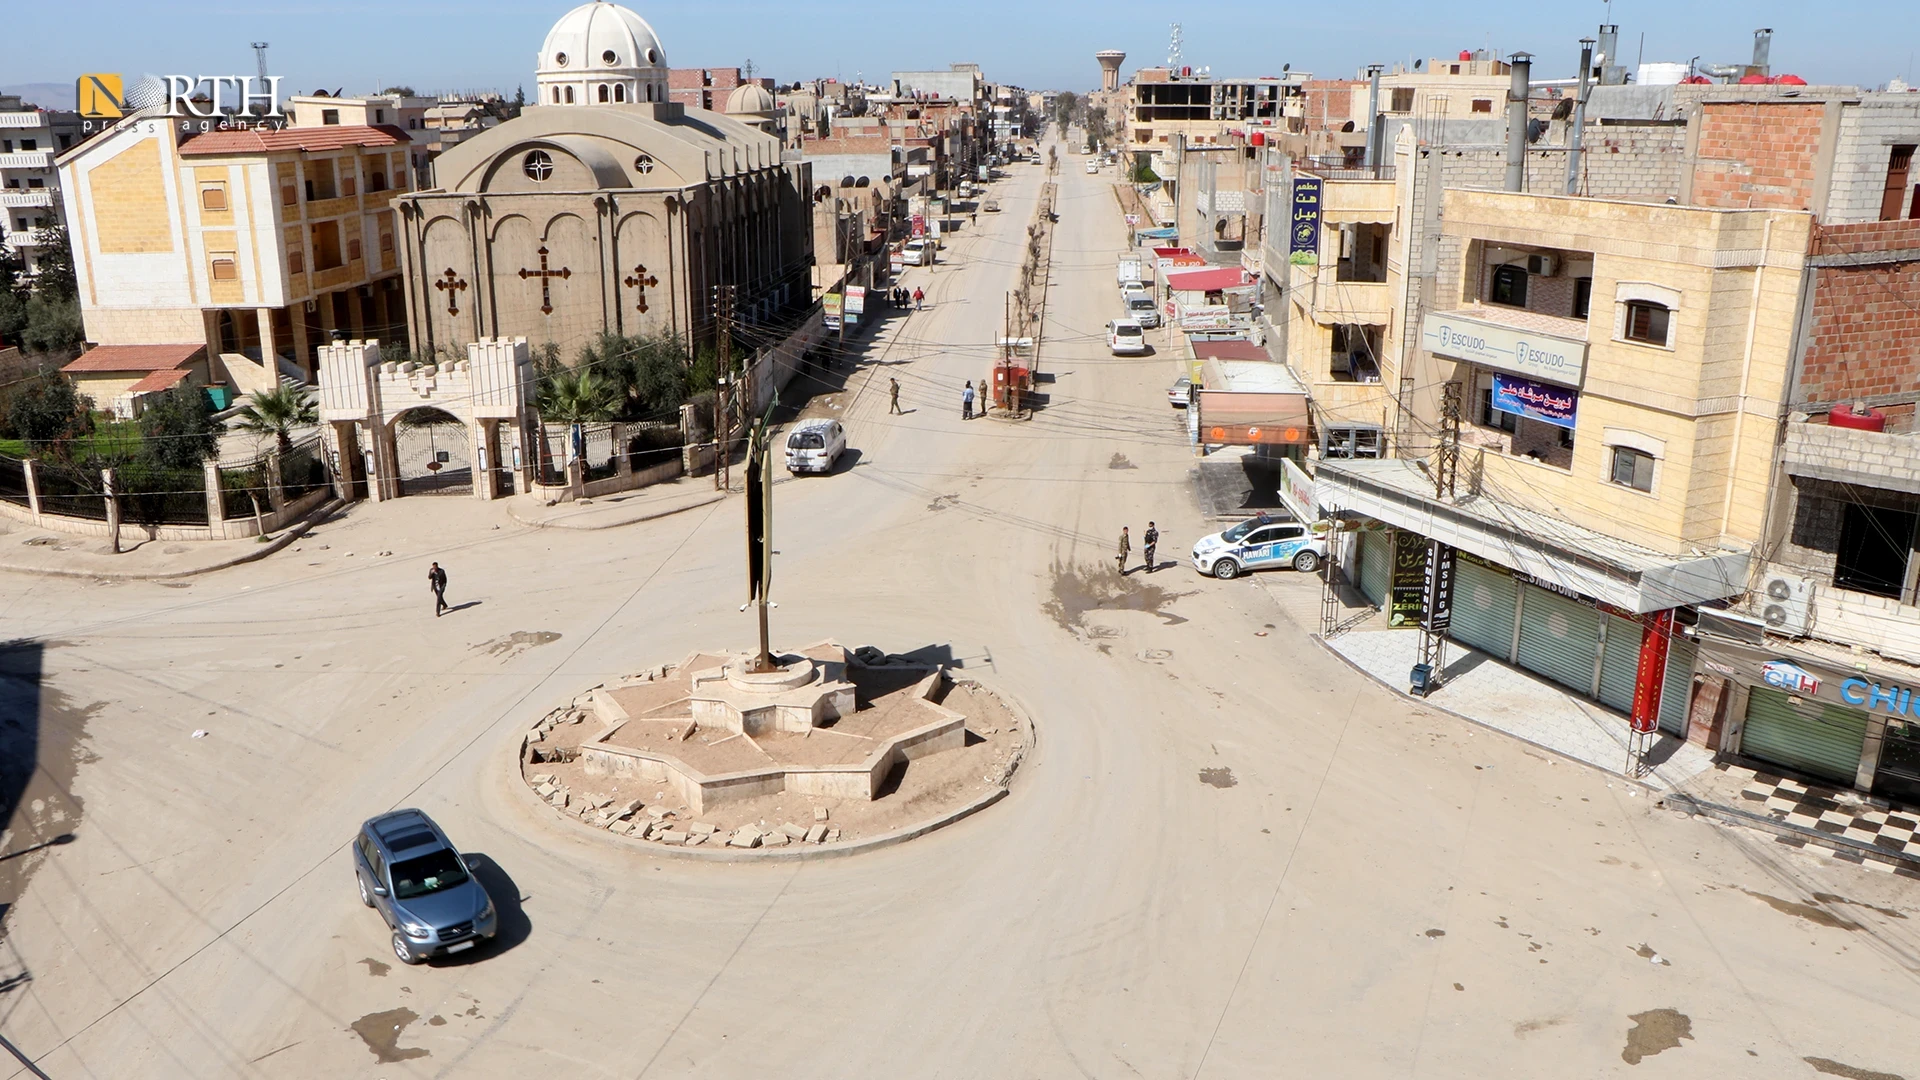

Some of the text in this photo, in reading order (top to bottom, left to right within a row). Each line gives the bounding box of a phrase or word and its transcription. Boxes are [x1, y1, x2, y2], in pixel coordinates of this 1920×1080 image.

[1296, 182, 1318, 191] مطعم
[1294, 208, 1317, 221] ميل
[1451, 333, 1485, 351] ESCUDO
[1528, 349, 1564, 368] ESCUDO
[1498, 383, 1518, 396] علي
[1242, 548, 1270, 560] HAWARI
[1422, 548, 1433, 613] SAMSUNG
[1529, 574, 1579, 600] SAMSUNG
[1764, 670, 1819, 695] CHH
[1840, 678, 1920, 716] CHI
